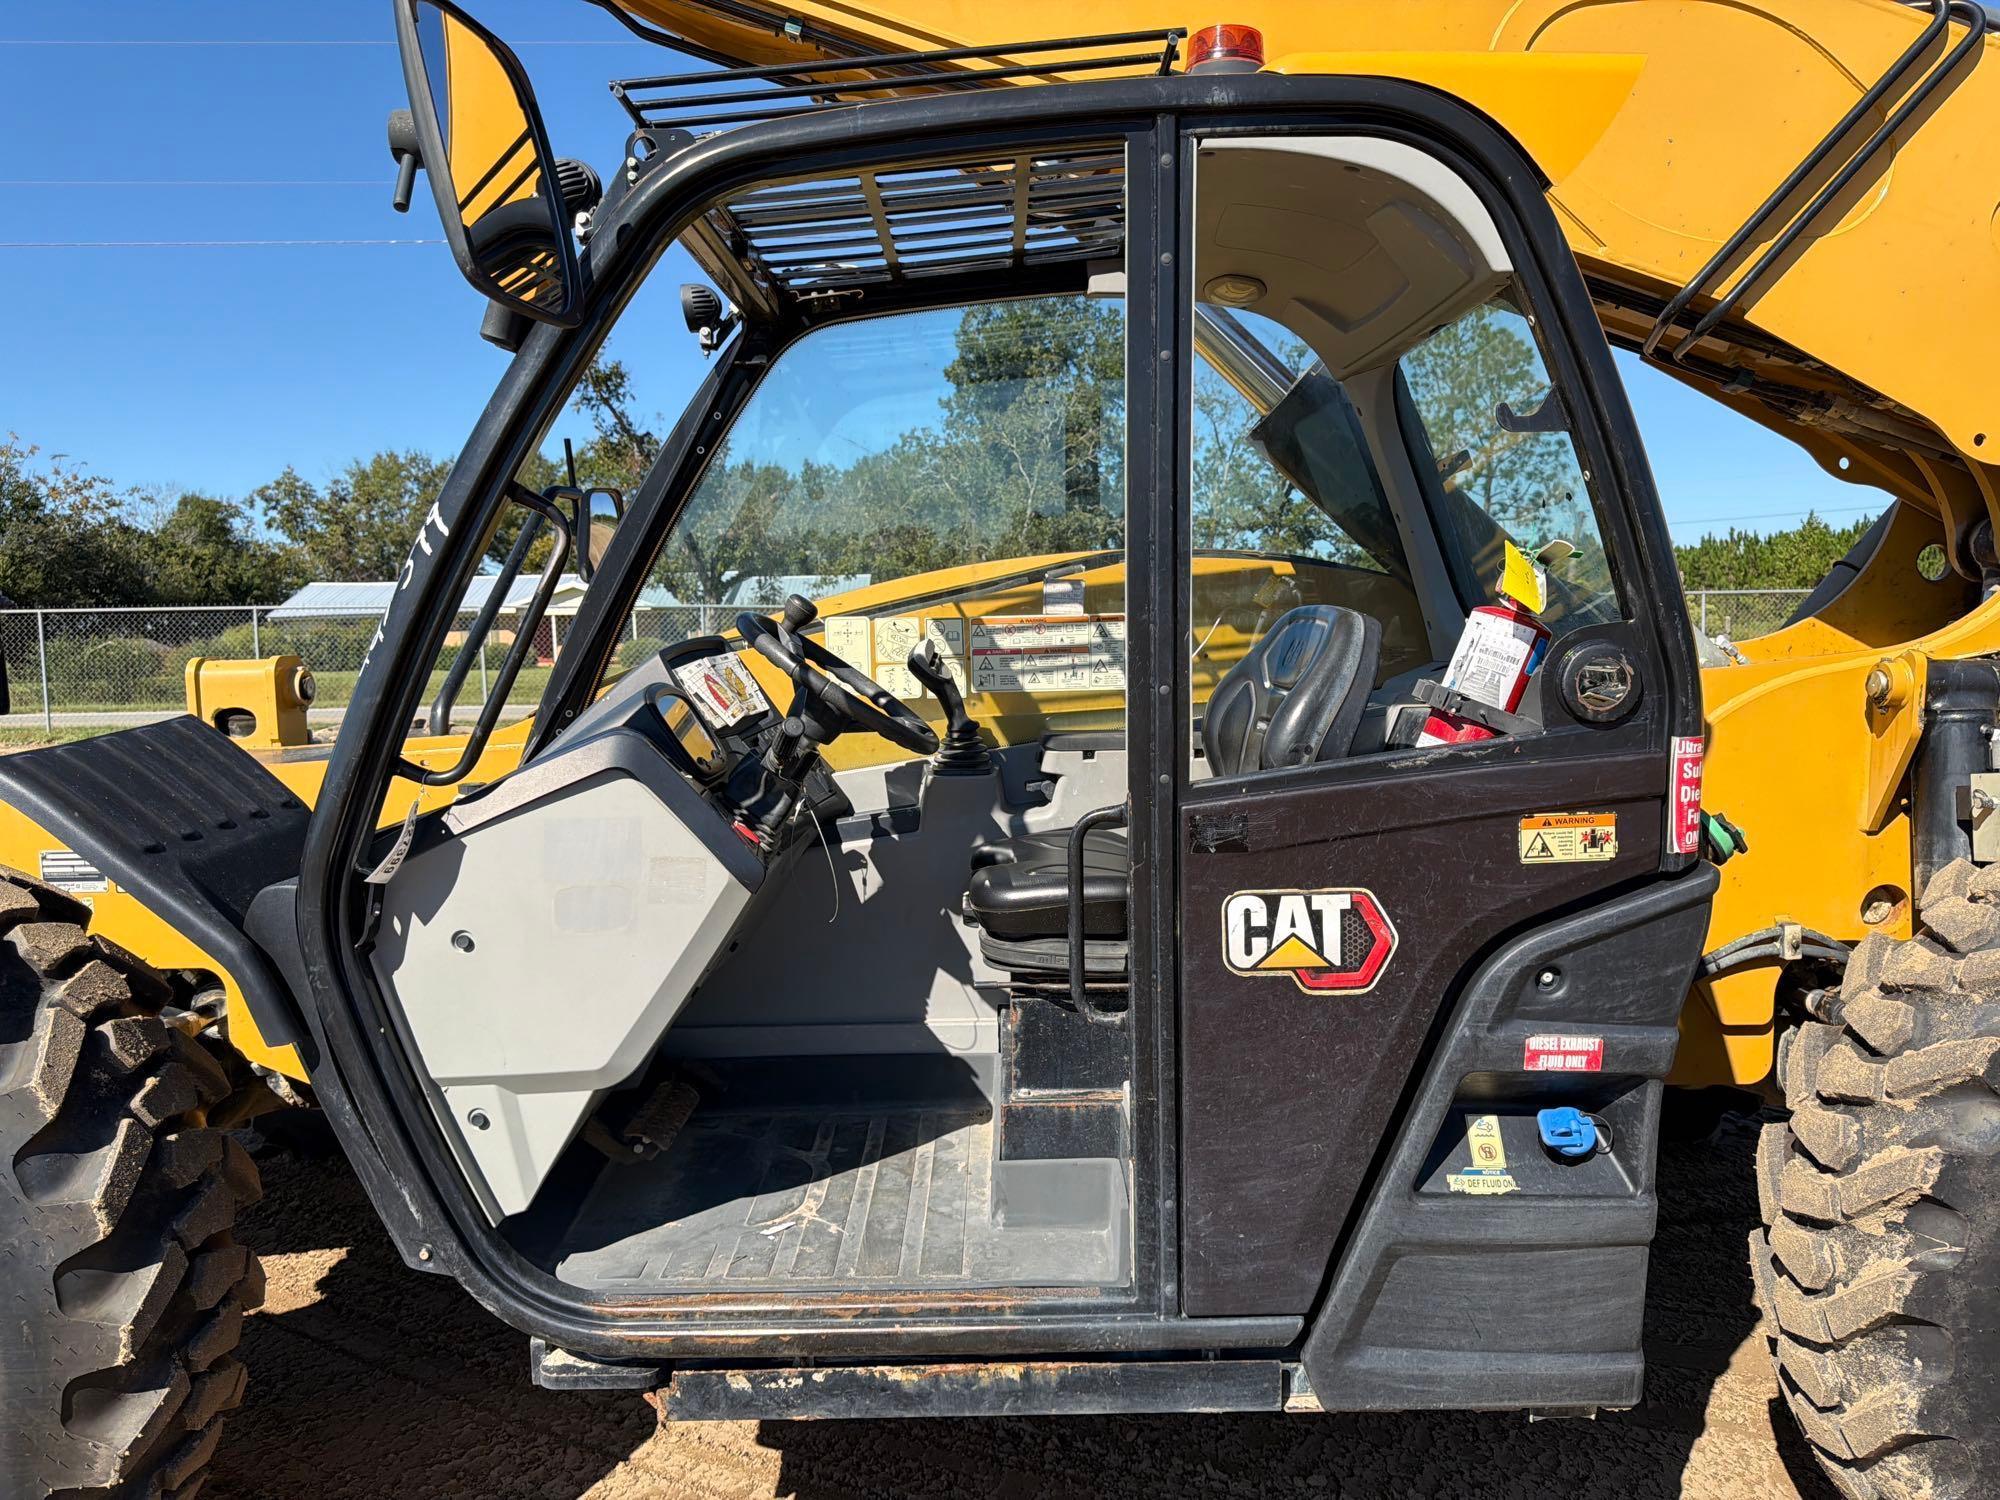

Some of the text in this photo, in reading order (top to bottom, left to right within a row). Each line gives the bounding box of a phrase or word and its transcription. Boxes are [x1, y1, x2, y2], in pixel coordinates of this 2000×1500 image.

[1554, 816, 1595, 826] WARNING
[1227, 893, 1351, 969] CAT
[1529, 1037, 1600, 1051] DIESEL EXHAUST
[1539, 1054, 1588, 1068] FLUID ONLY
[1467, 1179, 1481, 1188] DEF
[1482, 1179, 1502, 1188] FLUID
